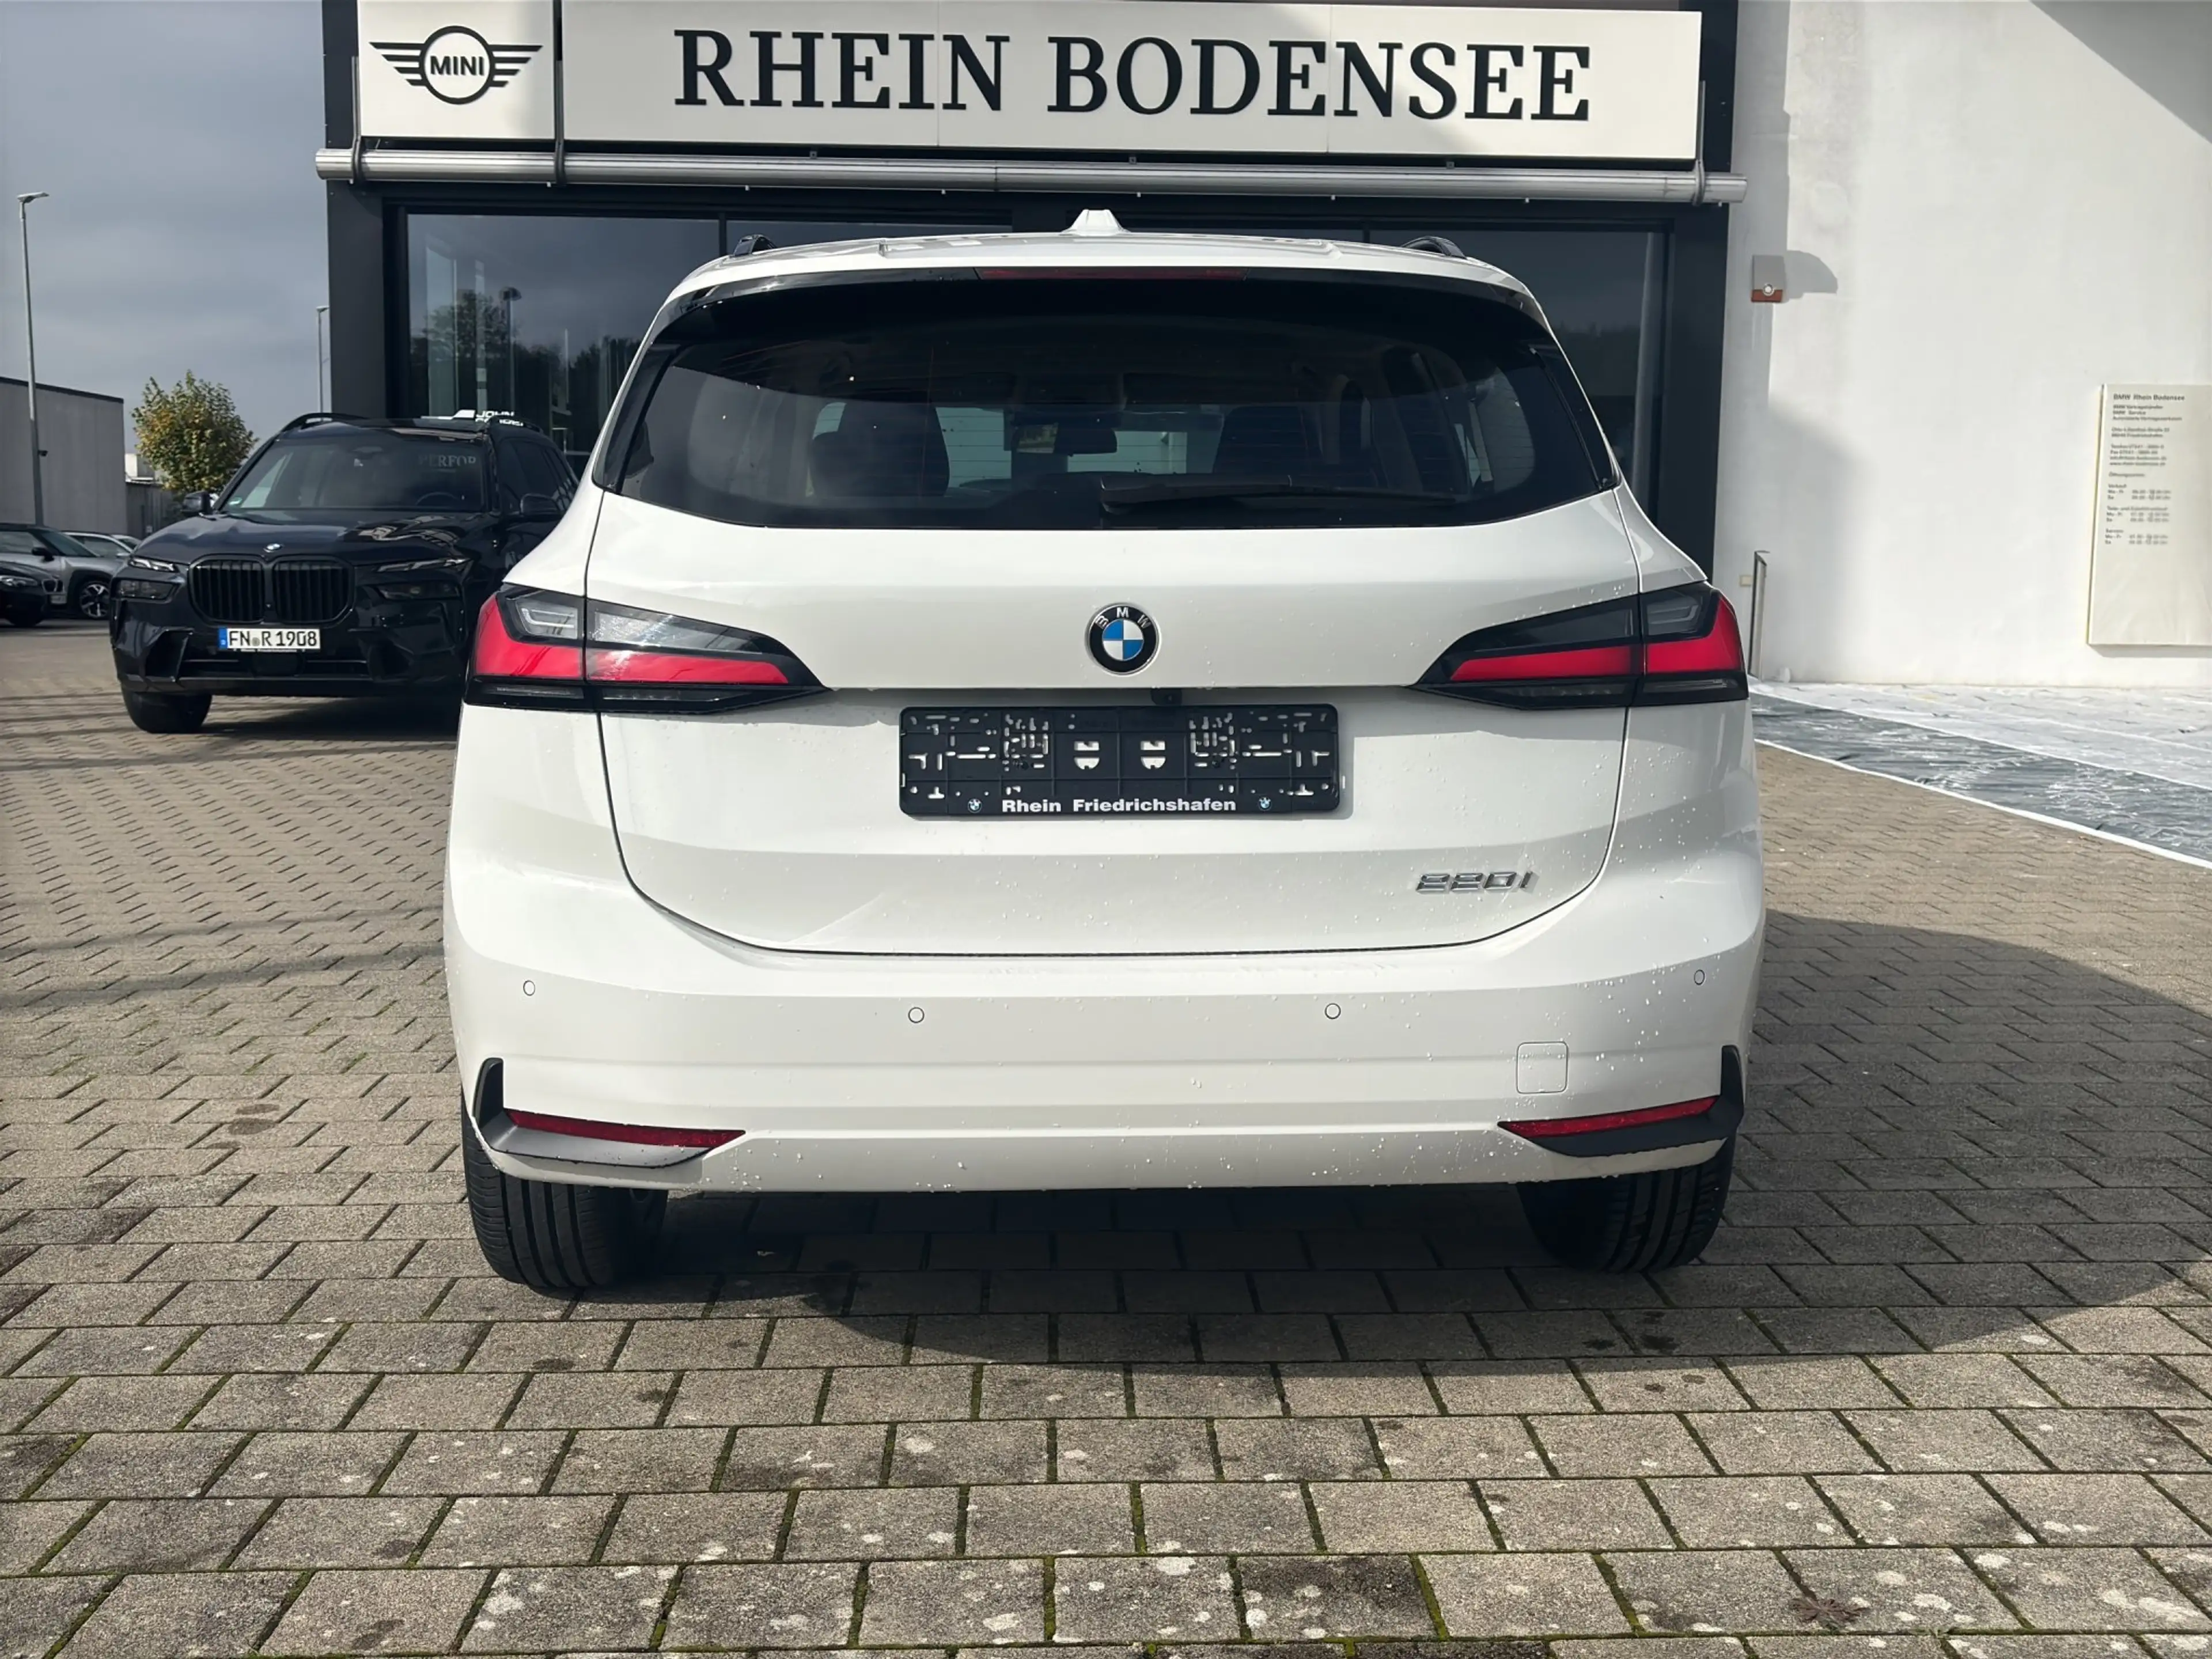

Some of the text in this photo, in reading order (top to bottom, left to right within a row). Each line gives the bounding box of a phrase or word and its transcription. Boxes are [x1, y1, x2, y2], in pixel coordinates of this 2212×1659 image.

[430, 55, 484, 76] MINI
[675, 30, 1589, 120] RHEIN BODENSEE
[1095, 607, 1152, 630] BMW
[229, 631, 317, 646] FN R 1908
[1002, 798, 1237, 812] Rhein Friedrichshafen
